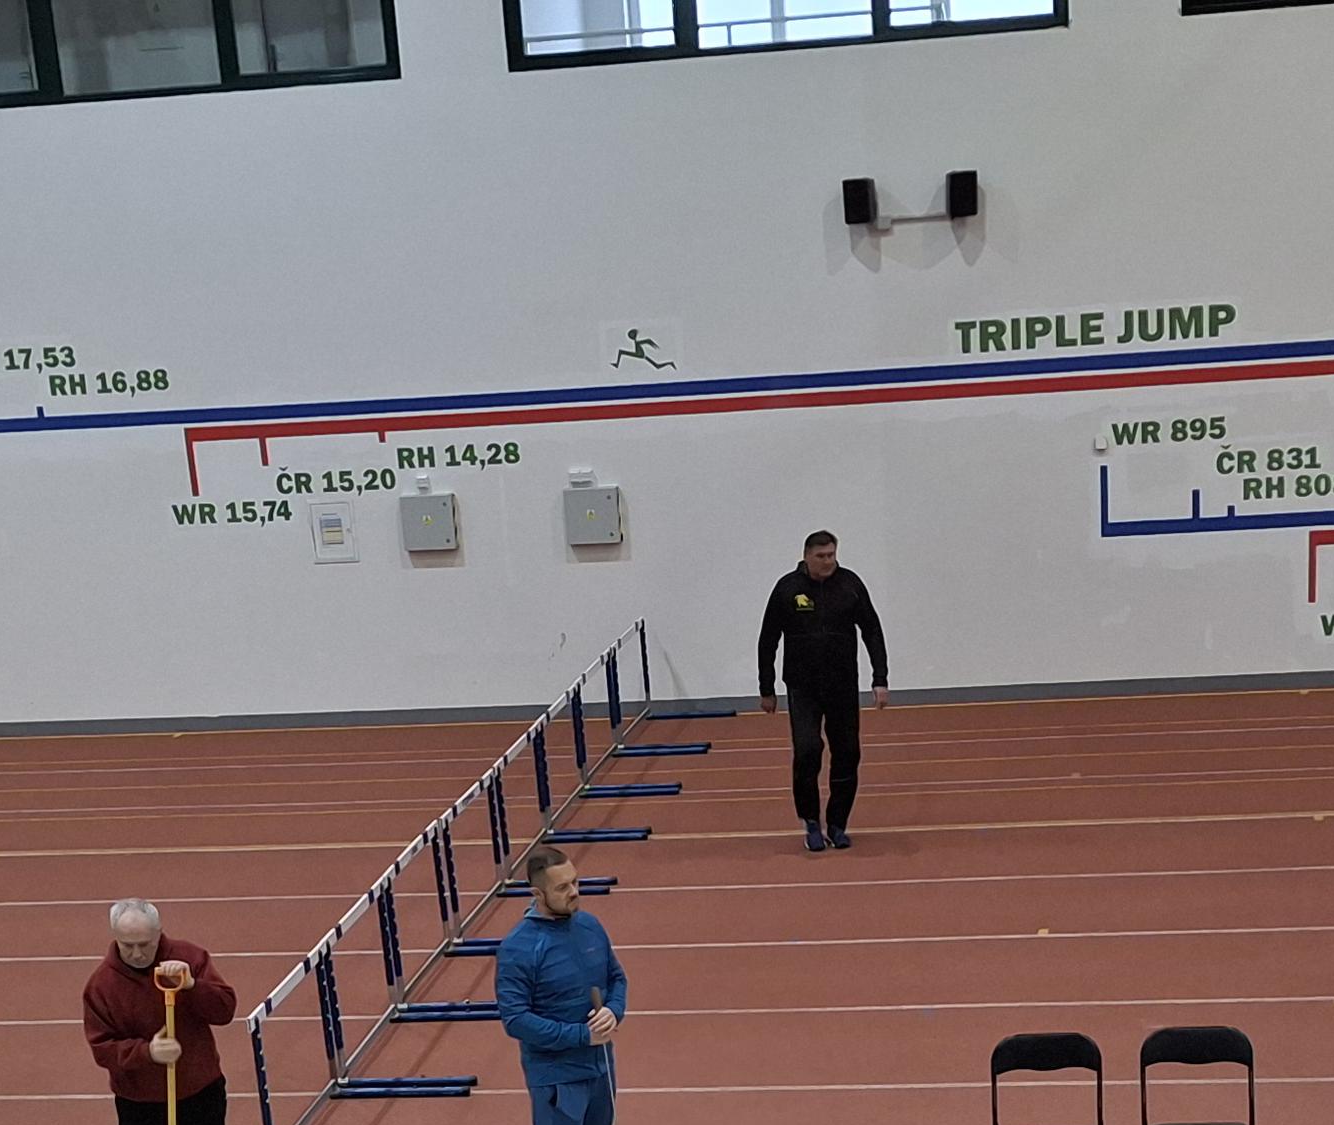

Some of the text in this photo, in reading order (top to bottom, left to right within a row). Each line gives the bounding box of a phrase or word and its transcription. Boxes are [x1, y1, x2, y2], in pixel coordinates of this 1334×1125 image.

[954, 303, 1237, 354] TRIPLE JUMP
[3, 345, 76, 374] 17,53
[48, 368, 170, 400] RH 16,88
[1111, 415, 1227, 446] WR 895
[396, 441, 521, 473] RH 14,28
[1216, 444, 1322, 475] ČR 831
[275, 466, 397, 499] ČR 15,20
[1242, 475, 1285, 501] RH
[171, 499, 293, 530] WR 15,74
